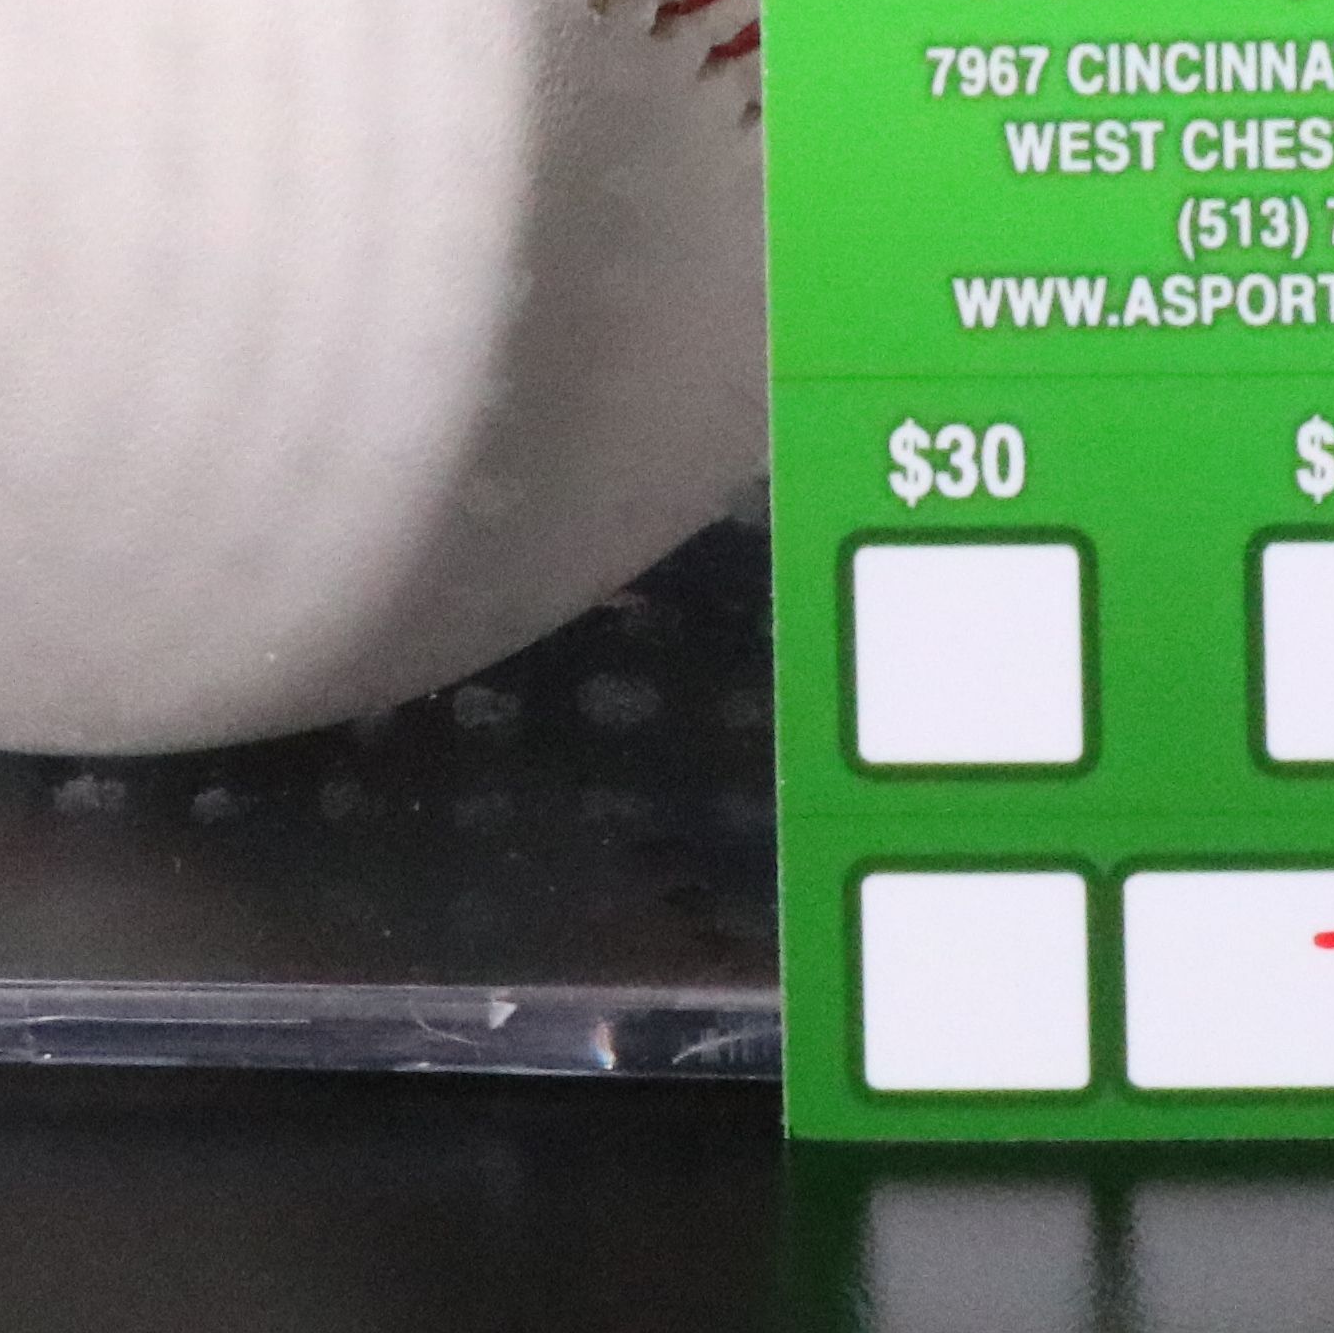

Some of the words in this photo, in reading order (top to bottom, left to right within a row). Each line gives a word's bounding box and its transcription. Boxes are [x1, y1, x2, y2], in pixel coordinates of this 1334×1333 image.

[927, 46, 1049, 96] 7967
[1006, 120, 1163, 172] WEST
[1179, 198, 1308, 258] (513)
[890, 419, 1025, 506] $30
